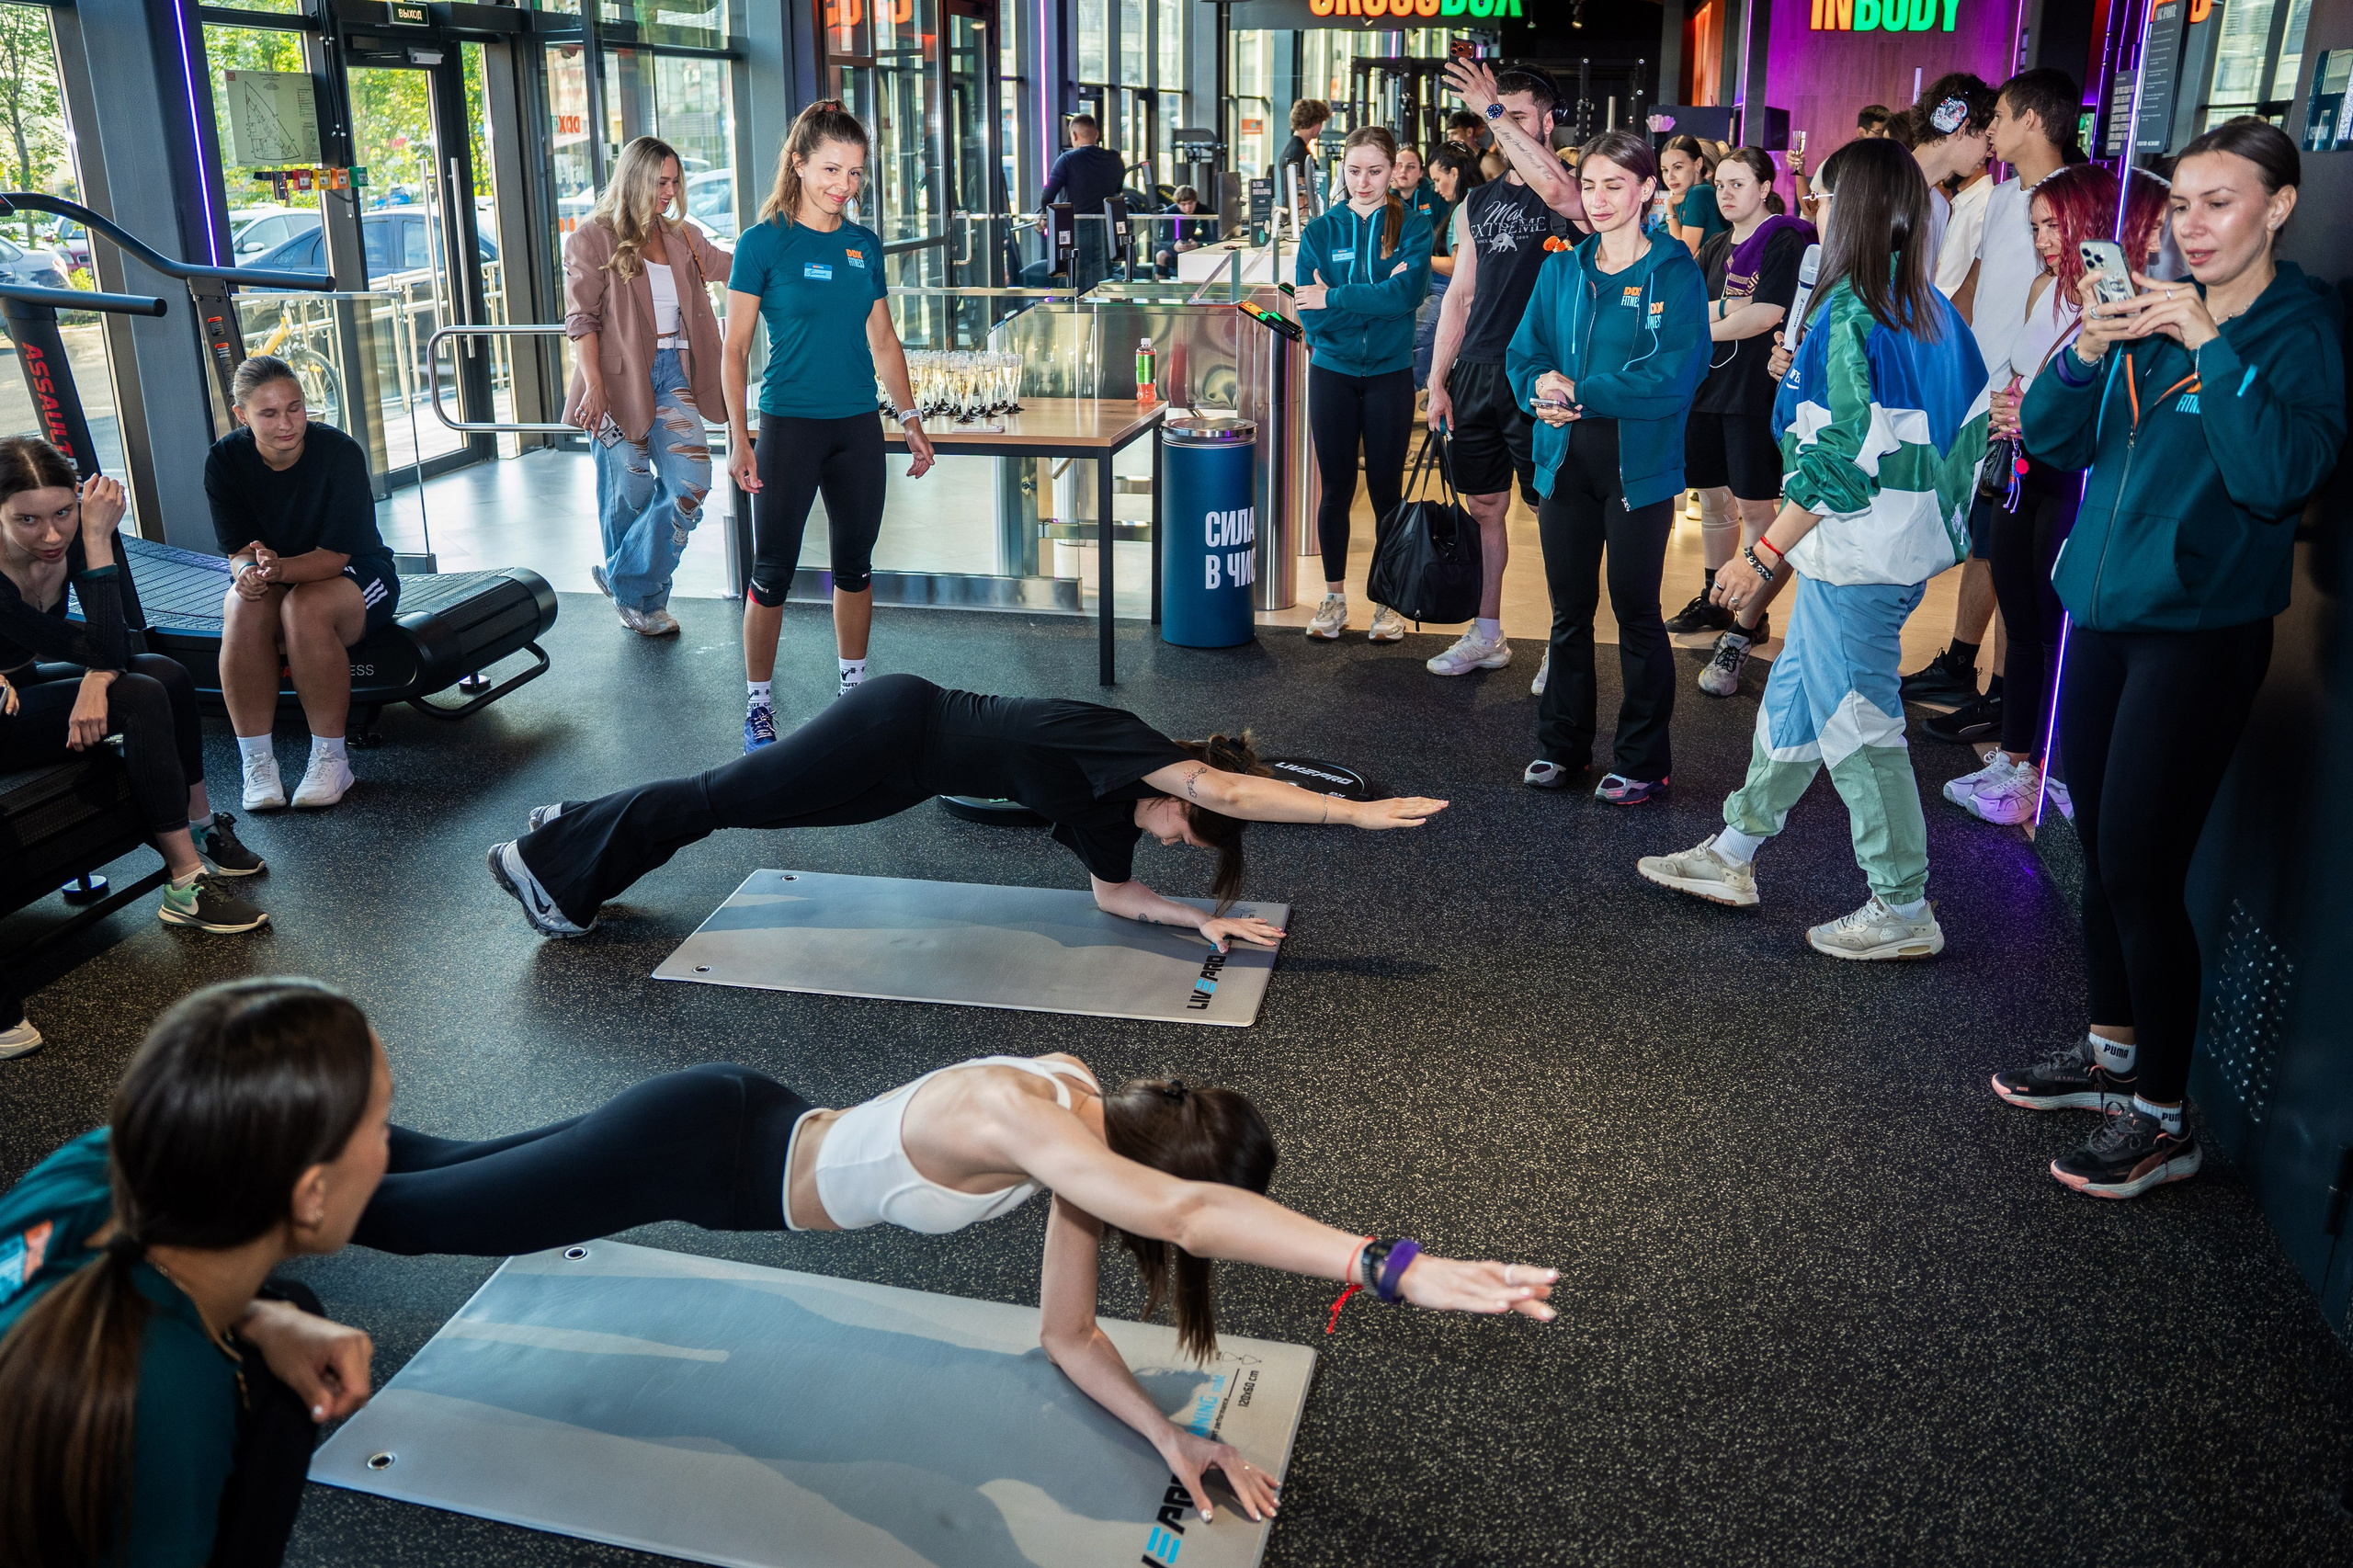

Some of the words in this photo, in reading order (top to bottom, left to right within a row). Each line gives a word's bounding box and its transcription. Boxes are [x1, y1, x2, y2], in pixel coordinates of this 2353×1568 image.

[398, 8, 423, 21] ВЫХОД
[1471, 216, 1547, 238] EXTREME
[846, 248, 863, 260] DDX
[1650, 301, 1665, 314] DX
[21, 341, 74, 458] ASSAULT
[2175, 393, 2200, 415] FITN
[1205, 506, 1256, 548] СИЛА
[1205, 554, 1221, 589] В
[350, 665, 374, 676] ESS
[1275, 761, 1354, 785] LIVEPRO
[1186, 954, 1227, 1010] LIVEPRO
[2104, 1042, 2130, 1060] PUMA
[2161, 1111, 2181, 1122] PUM
[1237, 1381, 1251, 1408] 120x60
[1246, 1369, 1259, 1382] cm
